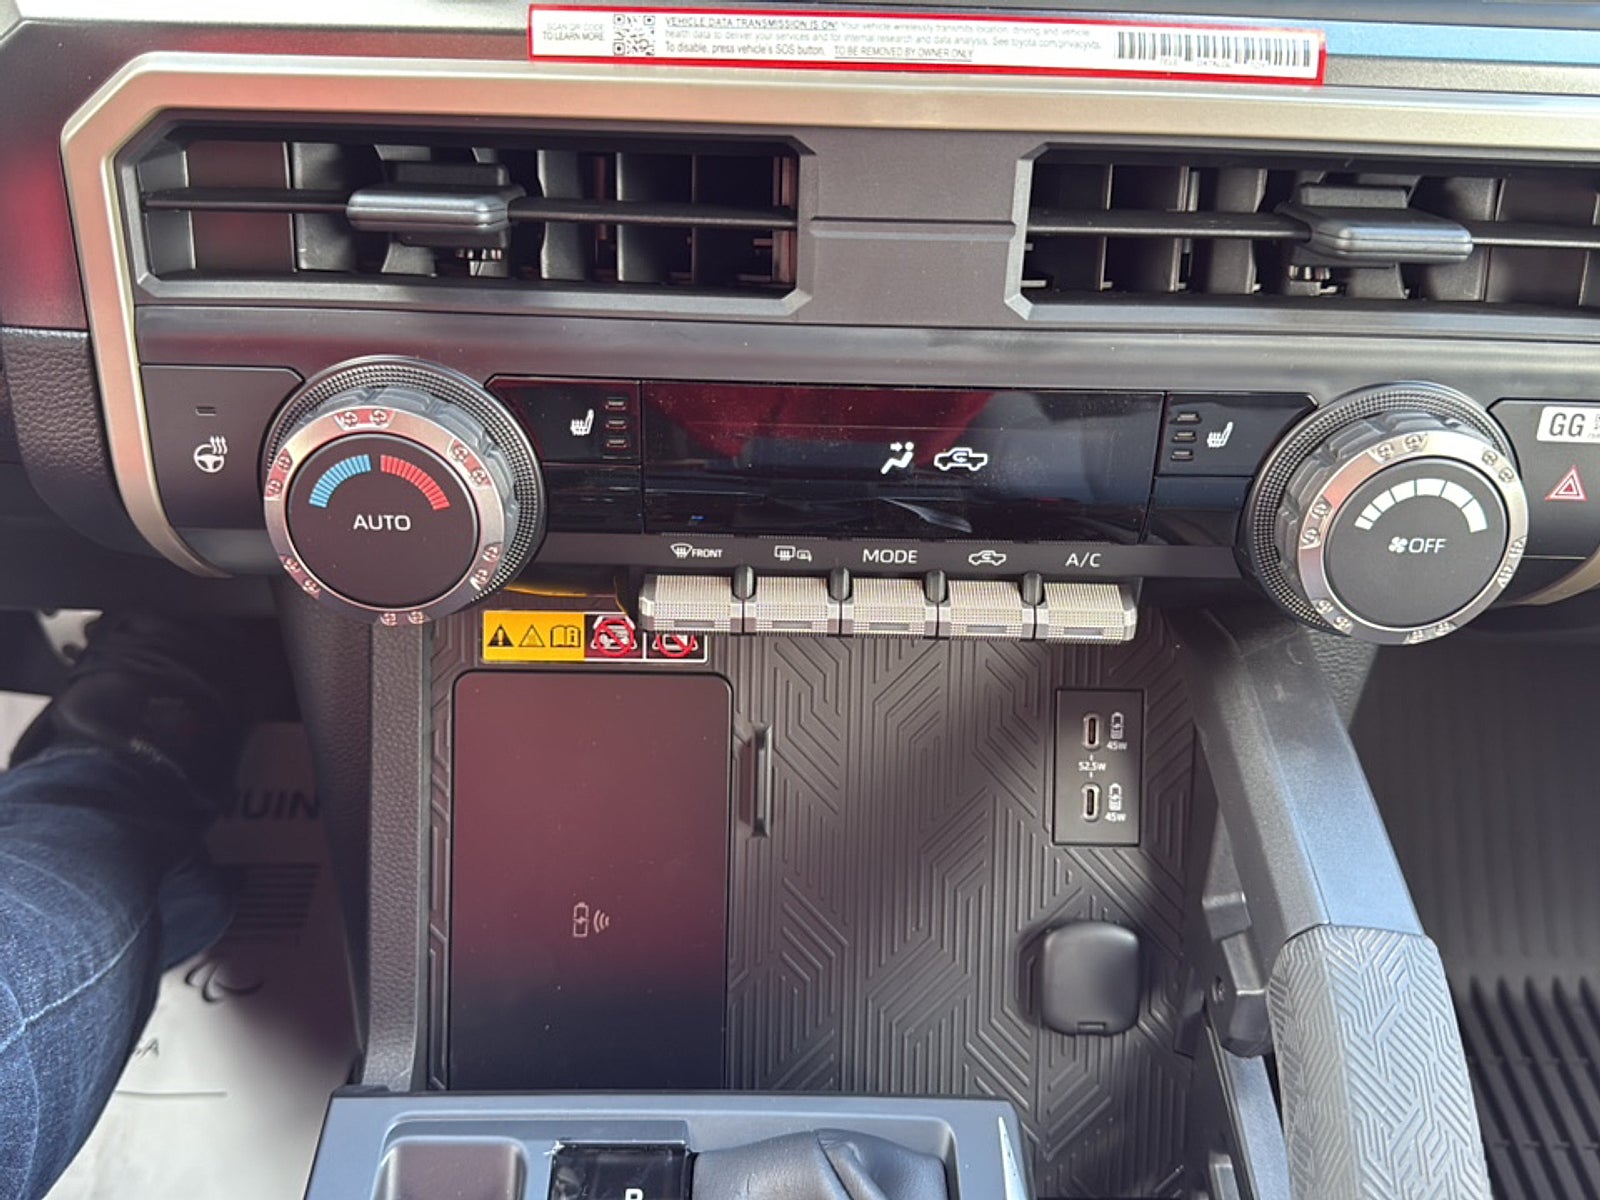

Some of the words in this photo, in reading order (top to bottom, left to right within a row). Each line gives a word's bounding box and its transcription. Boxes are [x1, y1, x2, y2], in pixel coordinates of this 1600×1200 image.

[665, 16, 705, 27] VEHICLE
[708, 17, 733, 28] DATA
[736, 18, 807, 29] TRANSMISSION
[810, 20, 819, 30] IS
[542, 30, 553, 40] TO
[554, 31, 581, 41] LEARN
[665, 40, 676, 52] To
[712, 43, 735, 55] press
[776, 43, 795, 55] SOS
[834, 45, 846, 56] TO
[847, 45, 859, 56] BE
[861, 45, 903, 57] REMOVED
[905, 47, 916, 57] BY
[918, 47, 949, 58] OWNER
[1549, 412, 1586, 437] GG
[353, 513, 411, 531] AUTO
[1408, 537, 1447, 553] OFF
[691, 547, 723, 559] FRONT
[862, 548, 919, 564] MODE
[1065, 551, 1102, 568] A/C
[1106, 740, 1128, 750] 45W
[1078, 761, 1107, 772] 52.5W
[1104, 811, 1127, 822] 45W
